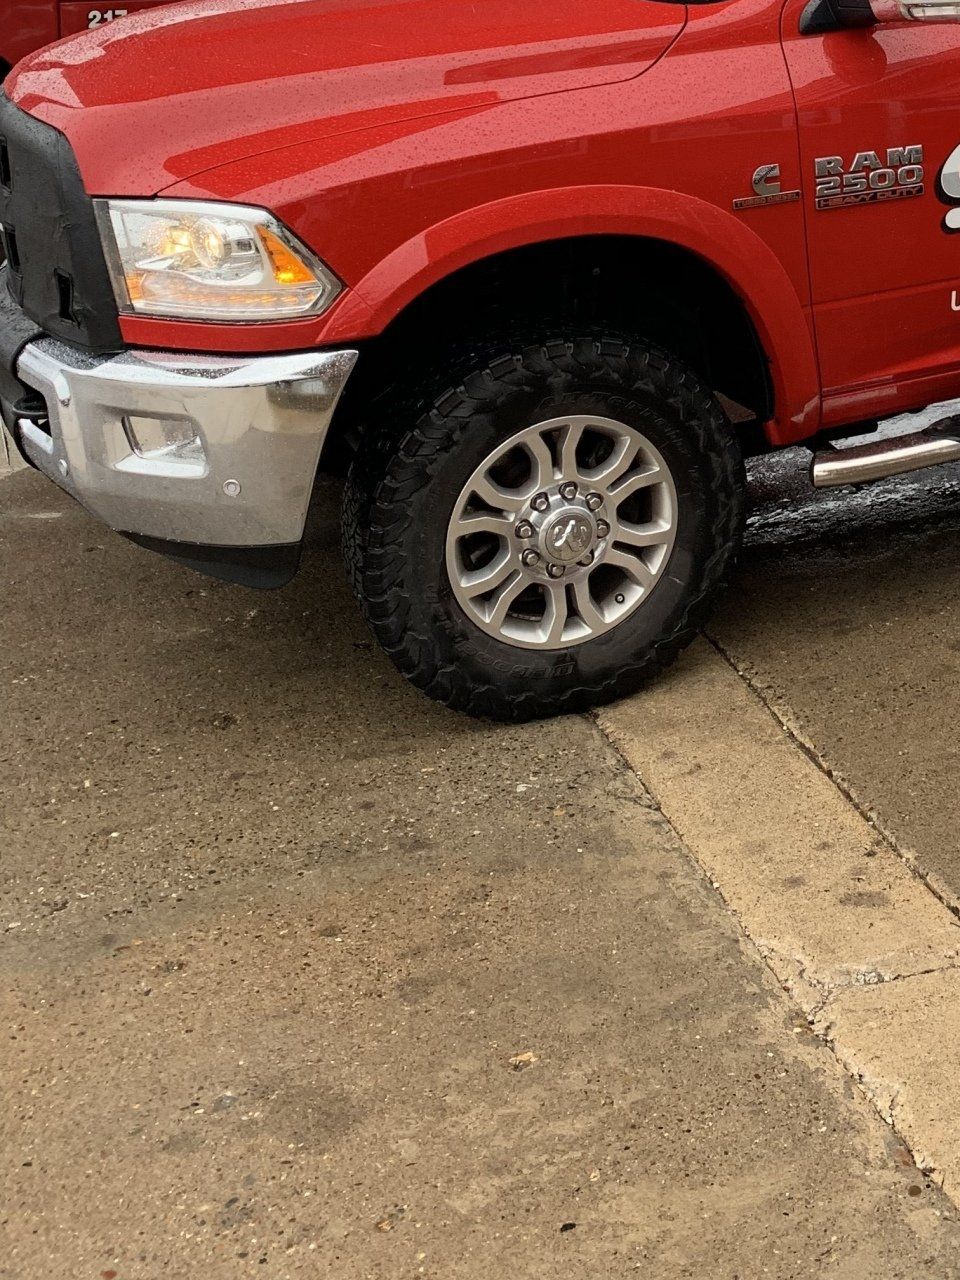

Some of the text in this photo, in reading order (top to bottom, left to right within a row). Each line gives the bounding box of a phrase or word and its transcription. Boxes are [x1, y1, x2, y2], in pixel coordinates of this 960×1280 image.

[814, 144, 923, 177] RAM
[815, 165, 924, 197] 2500
[820, 186, 919, 207] HEAVY DUTY
